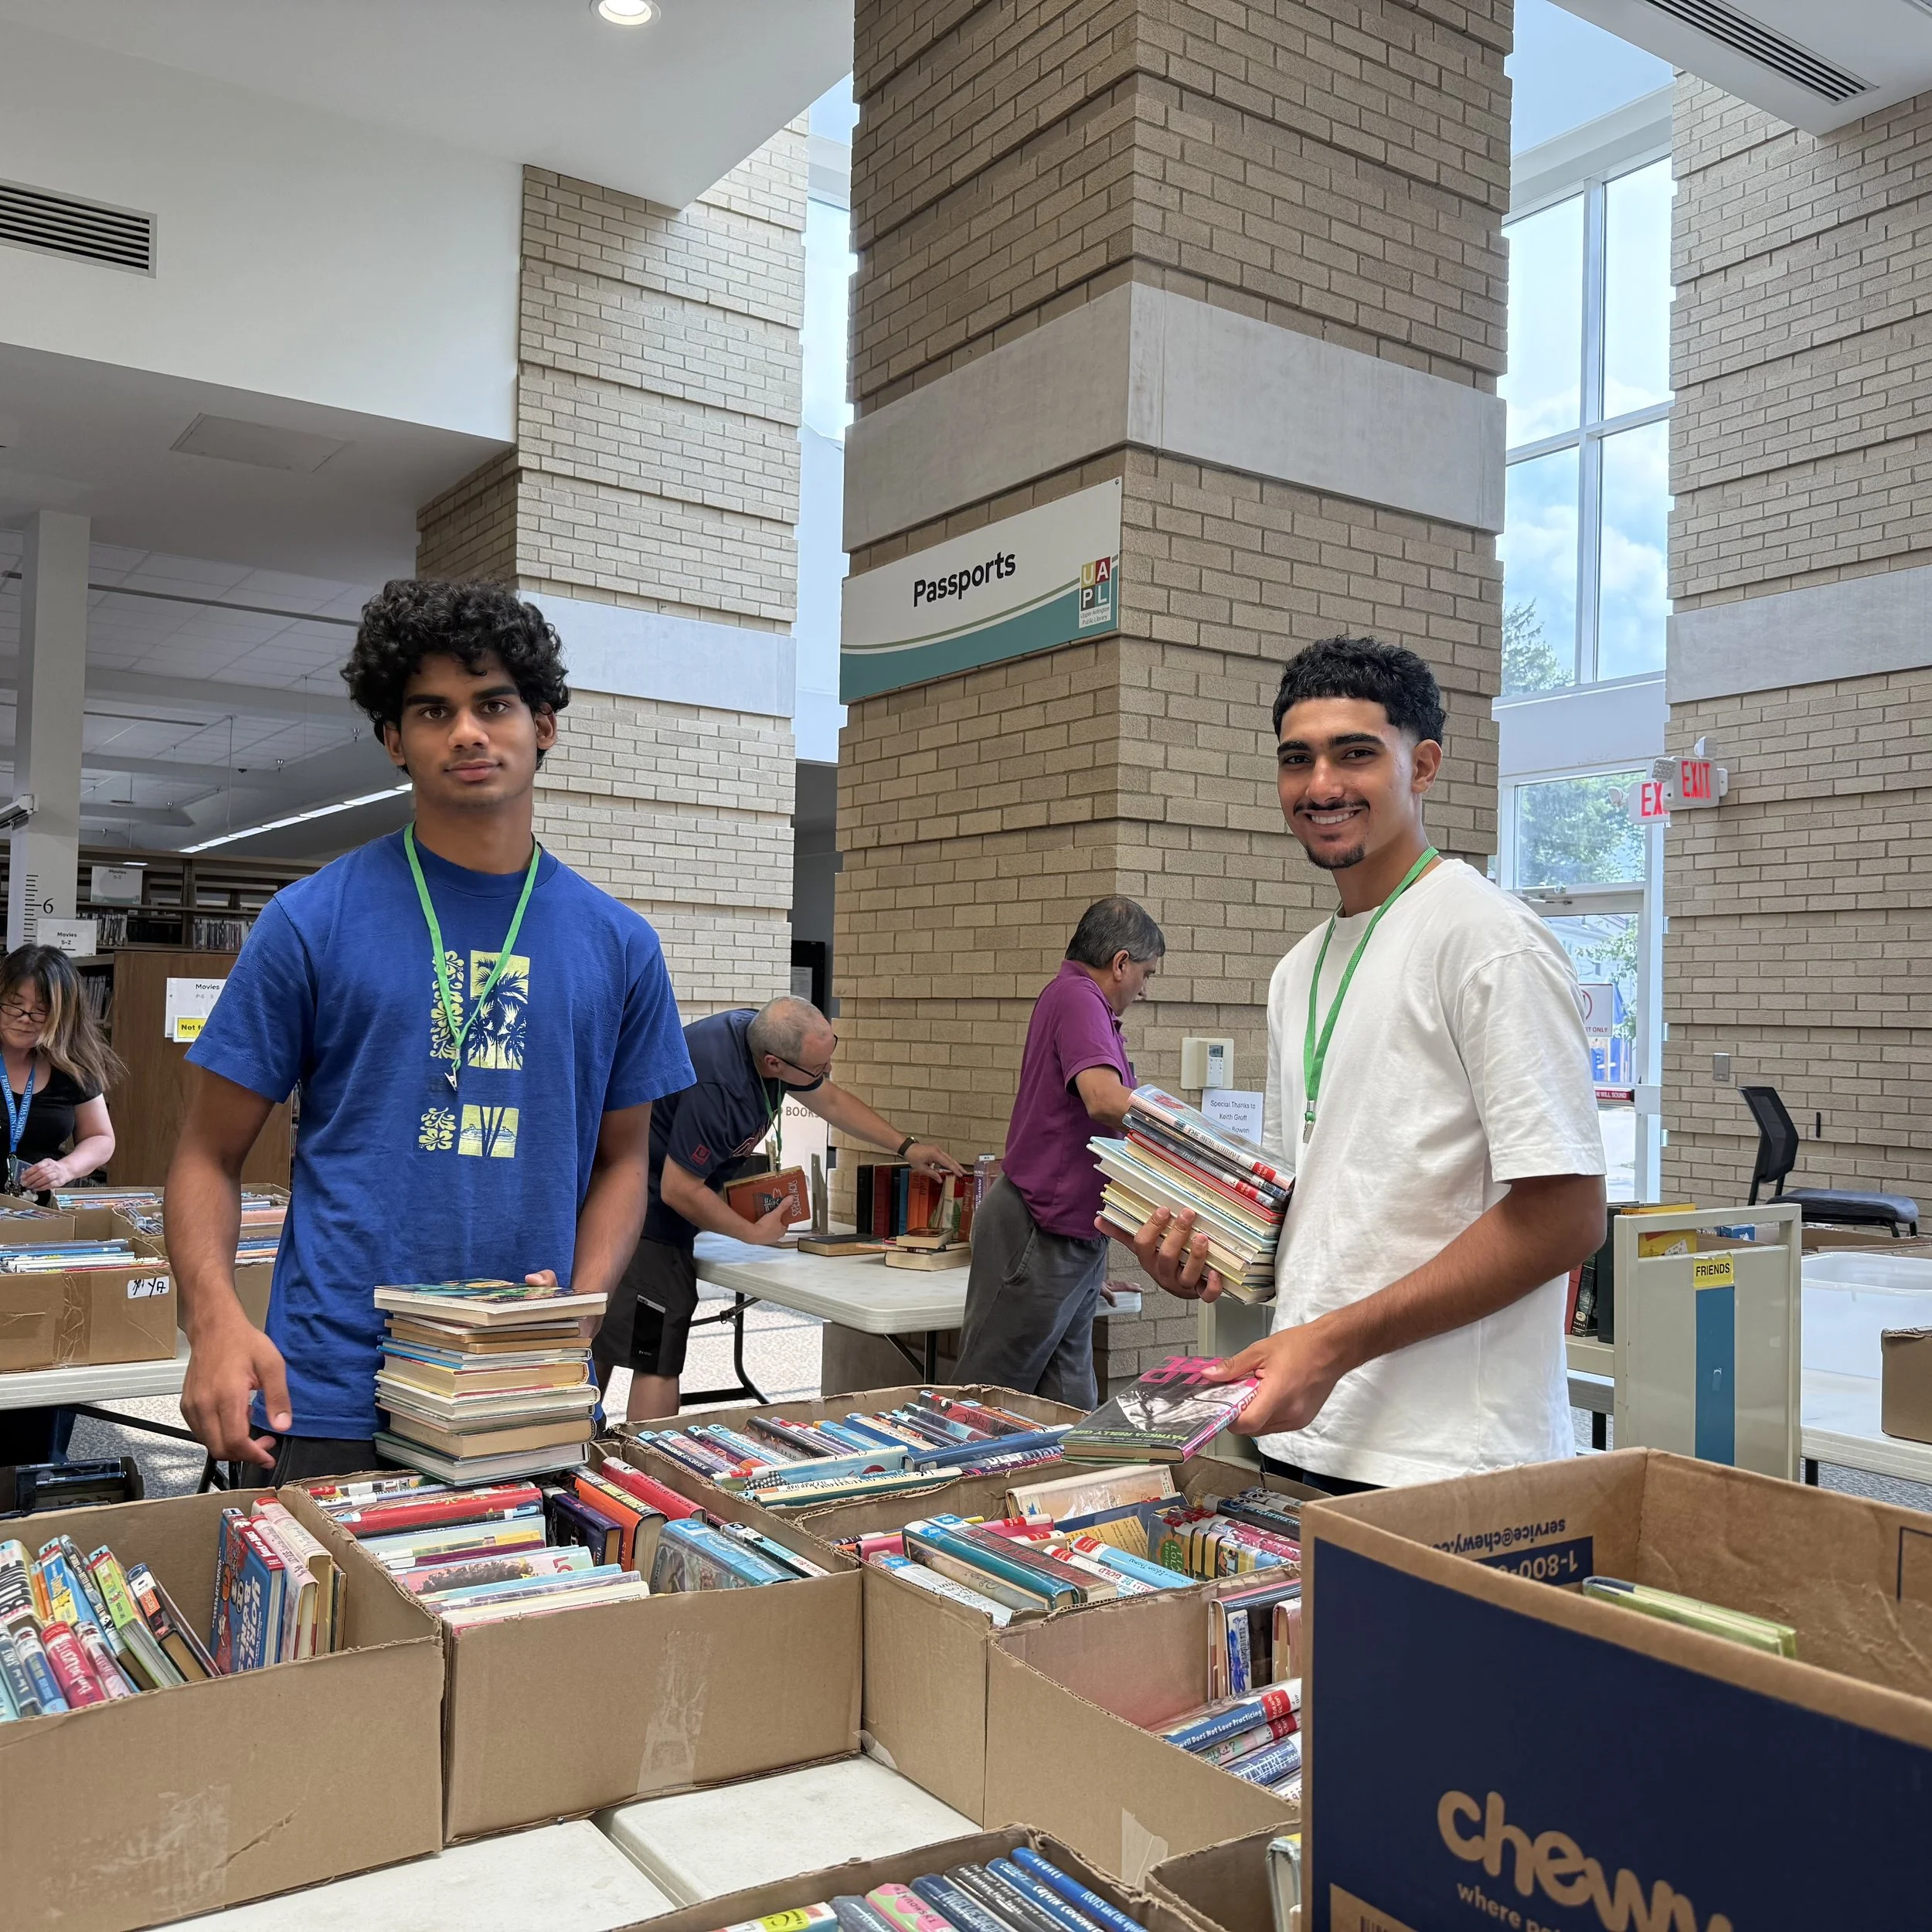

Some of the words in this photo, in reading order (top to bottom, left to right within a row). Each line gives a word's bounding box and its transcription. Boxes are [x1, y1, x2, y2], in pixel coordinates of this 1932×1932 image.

[913, 552, 1016, 607] Passports
[1083, 561, 1109, 584] UA
[1083, 585, 1107, 608] PL
[1080, 610, 1091, 618] Upper
[1092, 606, 1110, 615] Arlington
[1082, 617, 1094, 625] Public
[1094, 614, 1107, 623] Library
[1681, 760, 1711, 799] EXIT
[1641, 781, 1665, 817] EX
[43, 898, 54, 913] 6
[1696, 1263, 1730, 1277] FRIENDS
[148, 1277, 166, 1298] YA
[1432, 1519, 1566, 1554] service@chewy.c
[1098, 1568, 1121, 1579] GOLD
[1129, 1559, 1148, 1570] Thomas
[1148, 1564, 1165, 1576] Edison
[1495, 1549, 1578, 1580] 1-800-
[1192, 1733, 1206, 1743] Does
[1206, 1727, 1218, 1738] Not
[1218, 1721, 1233, 1732] Love
[1233, 1710, 1263, 1726] Practicing
[1034, 1856, 1063, 1880] HUGHES
[1014, 1894, 1039, 1916] Science
[1458, 1883, 1520, 1925] where
